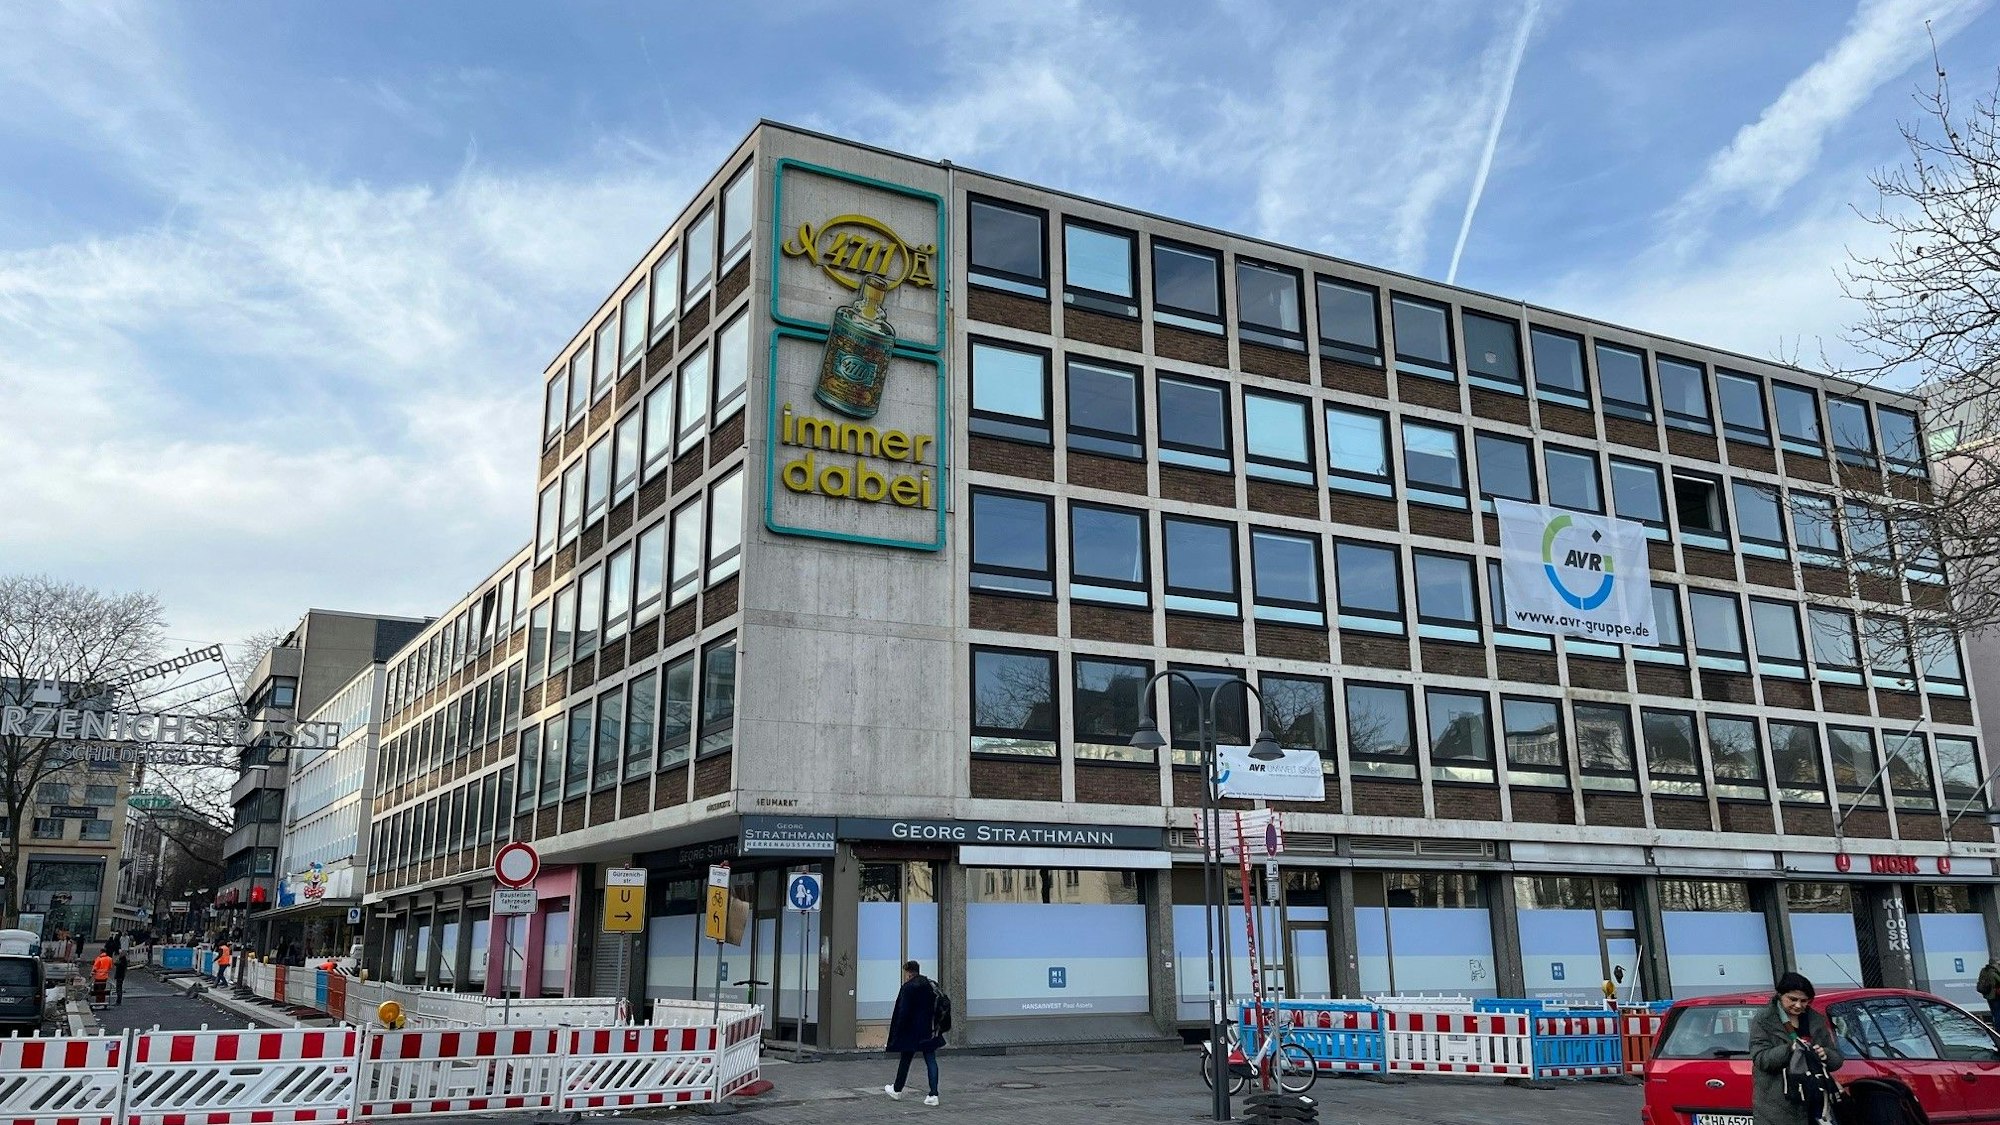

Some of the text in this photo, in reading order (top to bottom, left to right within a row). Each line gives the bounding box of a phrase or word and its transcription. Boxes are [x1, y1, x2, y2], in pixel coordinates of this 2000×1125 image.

[824, 231, 898, 276] 4711
[782, 400, 933, 464] immer
[782, 451, 932, 509] dabei
[1564, 549, 1602, 572] AVR
[1514, 610, 1650, 638] www.avr-gruppe.de
[1249, 763, 1266, 773] AVR
[745, 828, 835, 840] STRATHMANN
[777, 822, 804, 830] GEORG
[891, 822, 1114, 845] GEORG STRATHMANN
[1870, 855, 1920, 874] KIOSK
[620, 889, 631, 903] U
[1883, 899, 1901, 951] KIOSK
[1894, 898, 1910, 950] KIOSK
